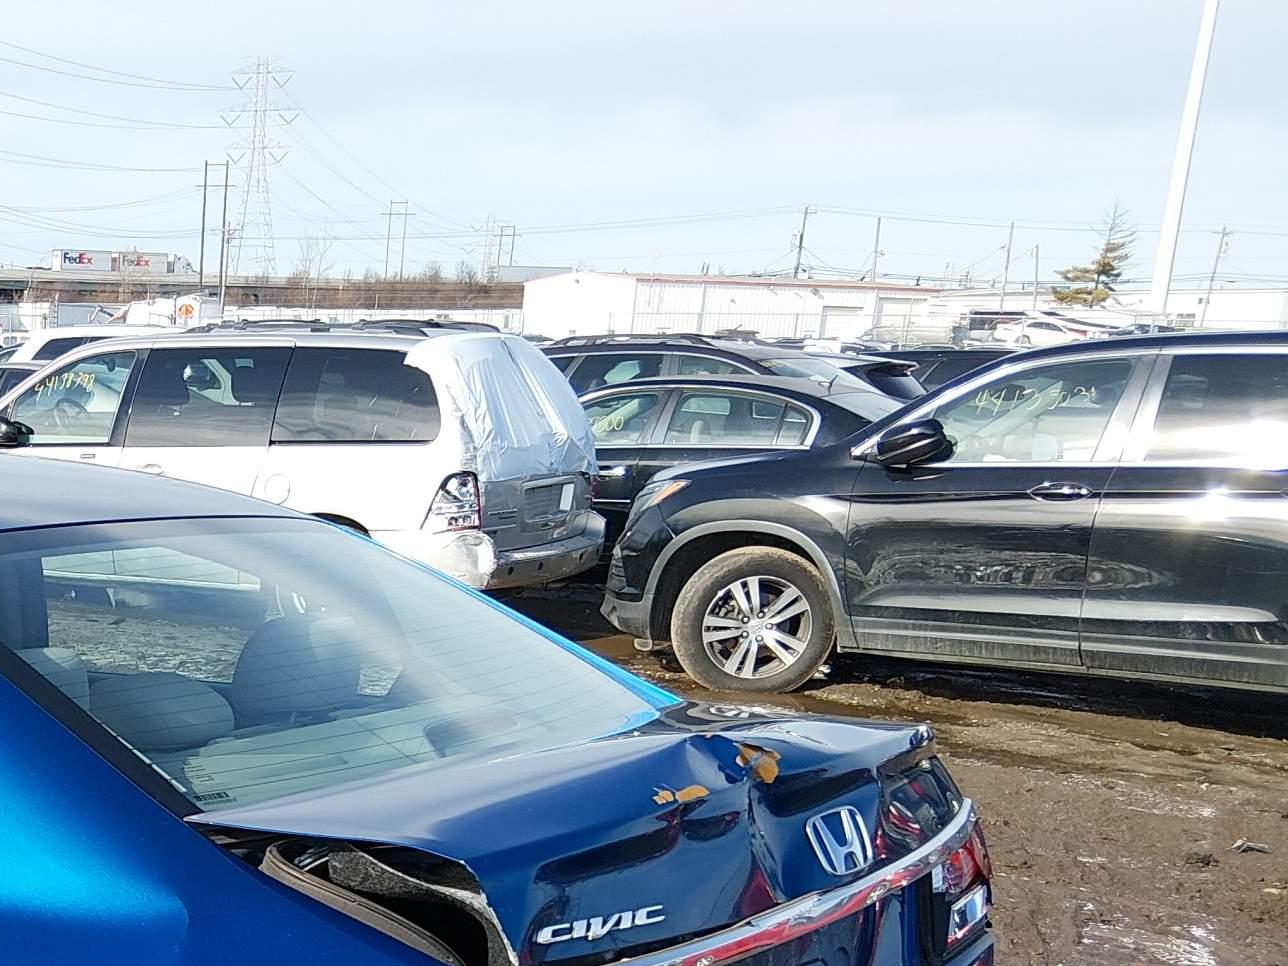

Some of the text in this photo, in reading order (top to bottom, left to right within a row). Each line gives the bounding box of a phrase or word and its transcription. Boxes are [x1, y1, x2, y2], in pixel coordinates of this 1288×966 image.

[63, 252, 93, 265] FedEx
[122, 255, 150, 267] FedEx
[536, 904, 666, 945] CIVIC
